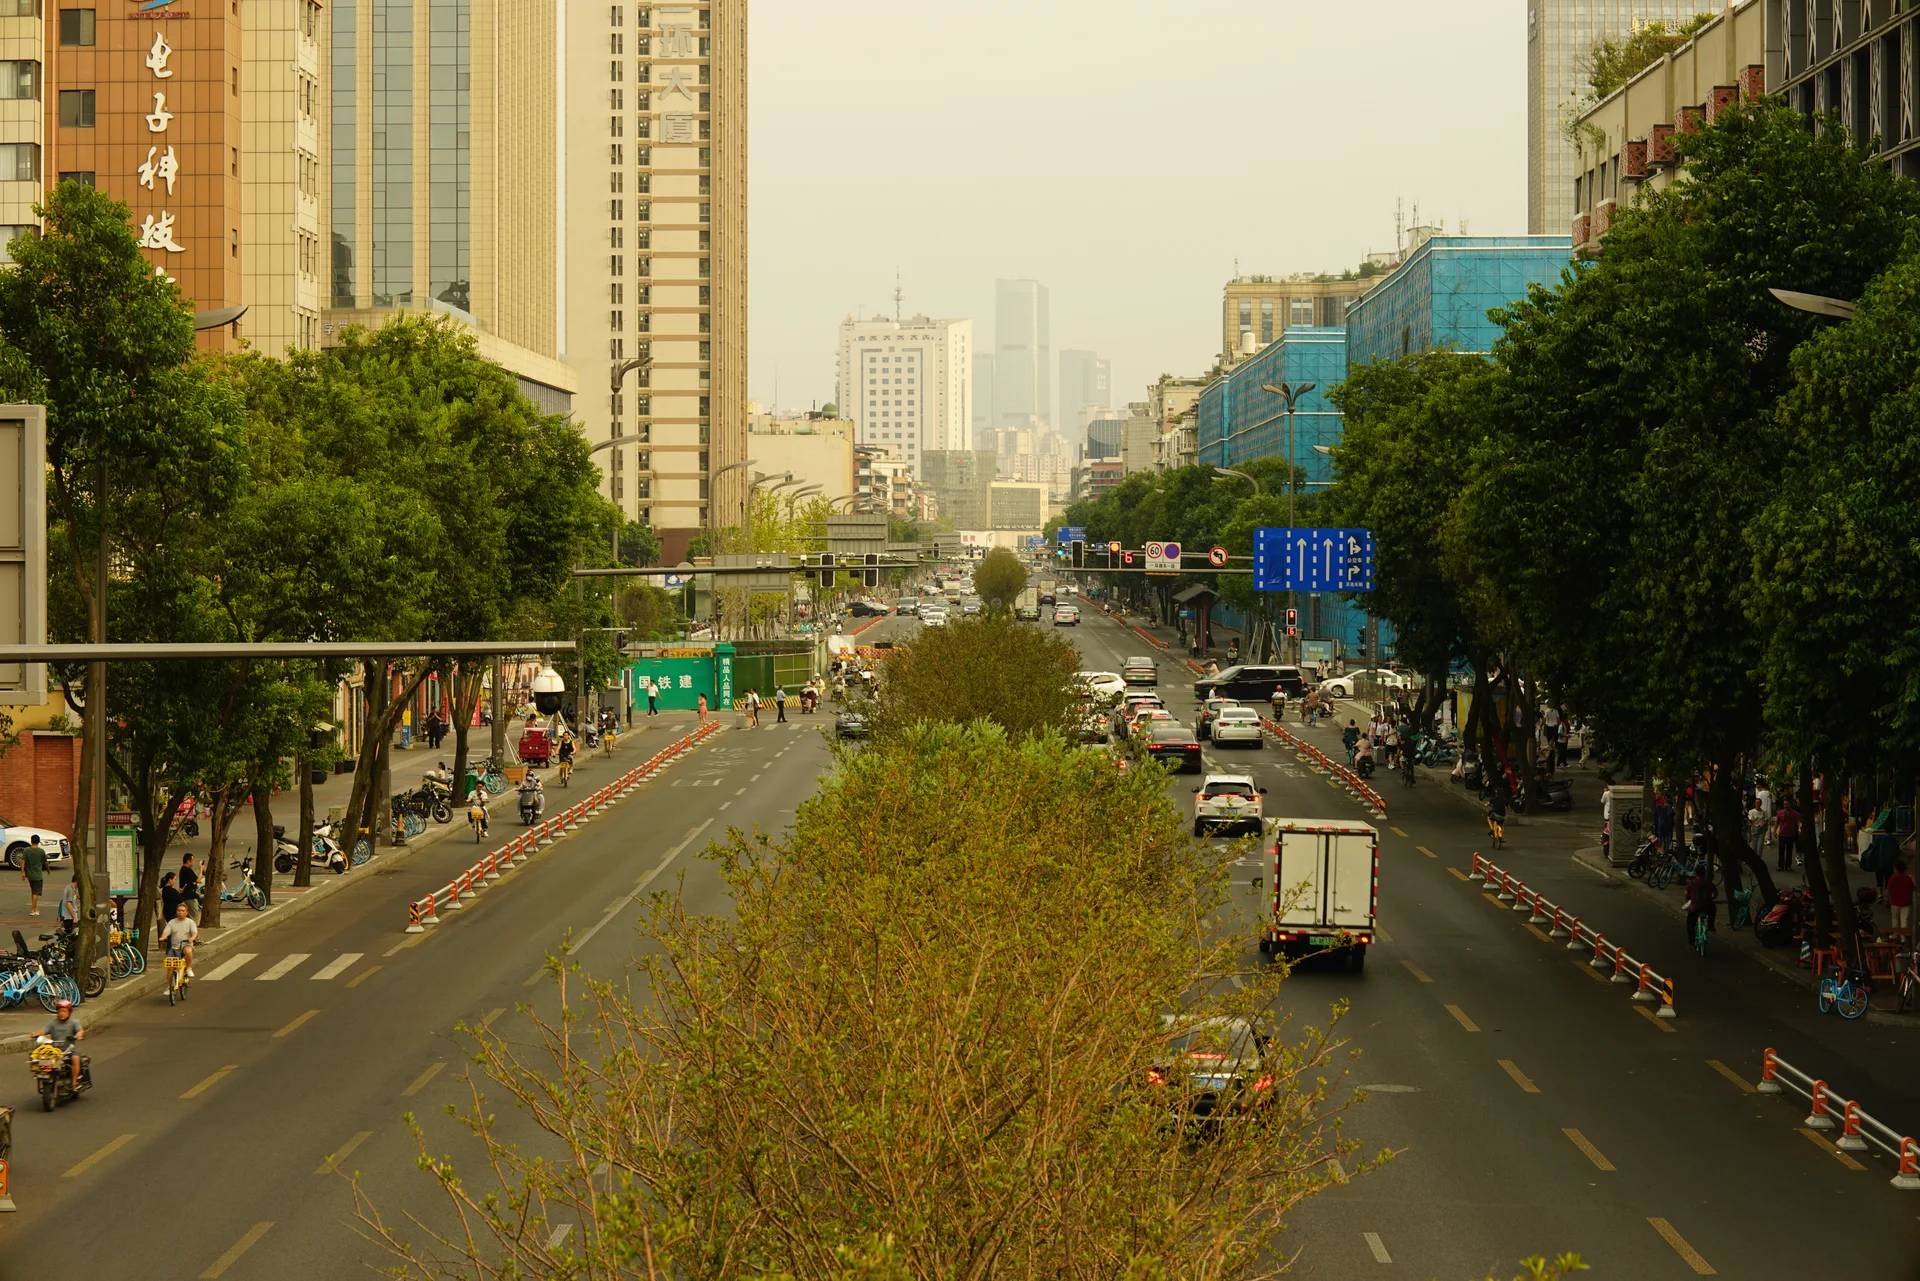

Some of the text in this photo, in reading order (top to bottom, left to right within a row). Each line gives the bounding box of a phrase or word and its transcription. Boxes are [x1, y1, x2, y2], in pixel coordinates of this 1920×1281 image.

[137, 32, 186, 284] 电子科技
[1124, 552, 1133, 564] 6
[1150, 547, 1159, 555] 60
[722, 657, 730, 705] 精品人品同在
